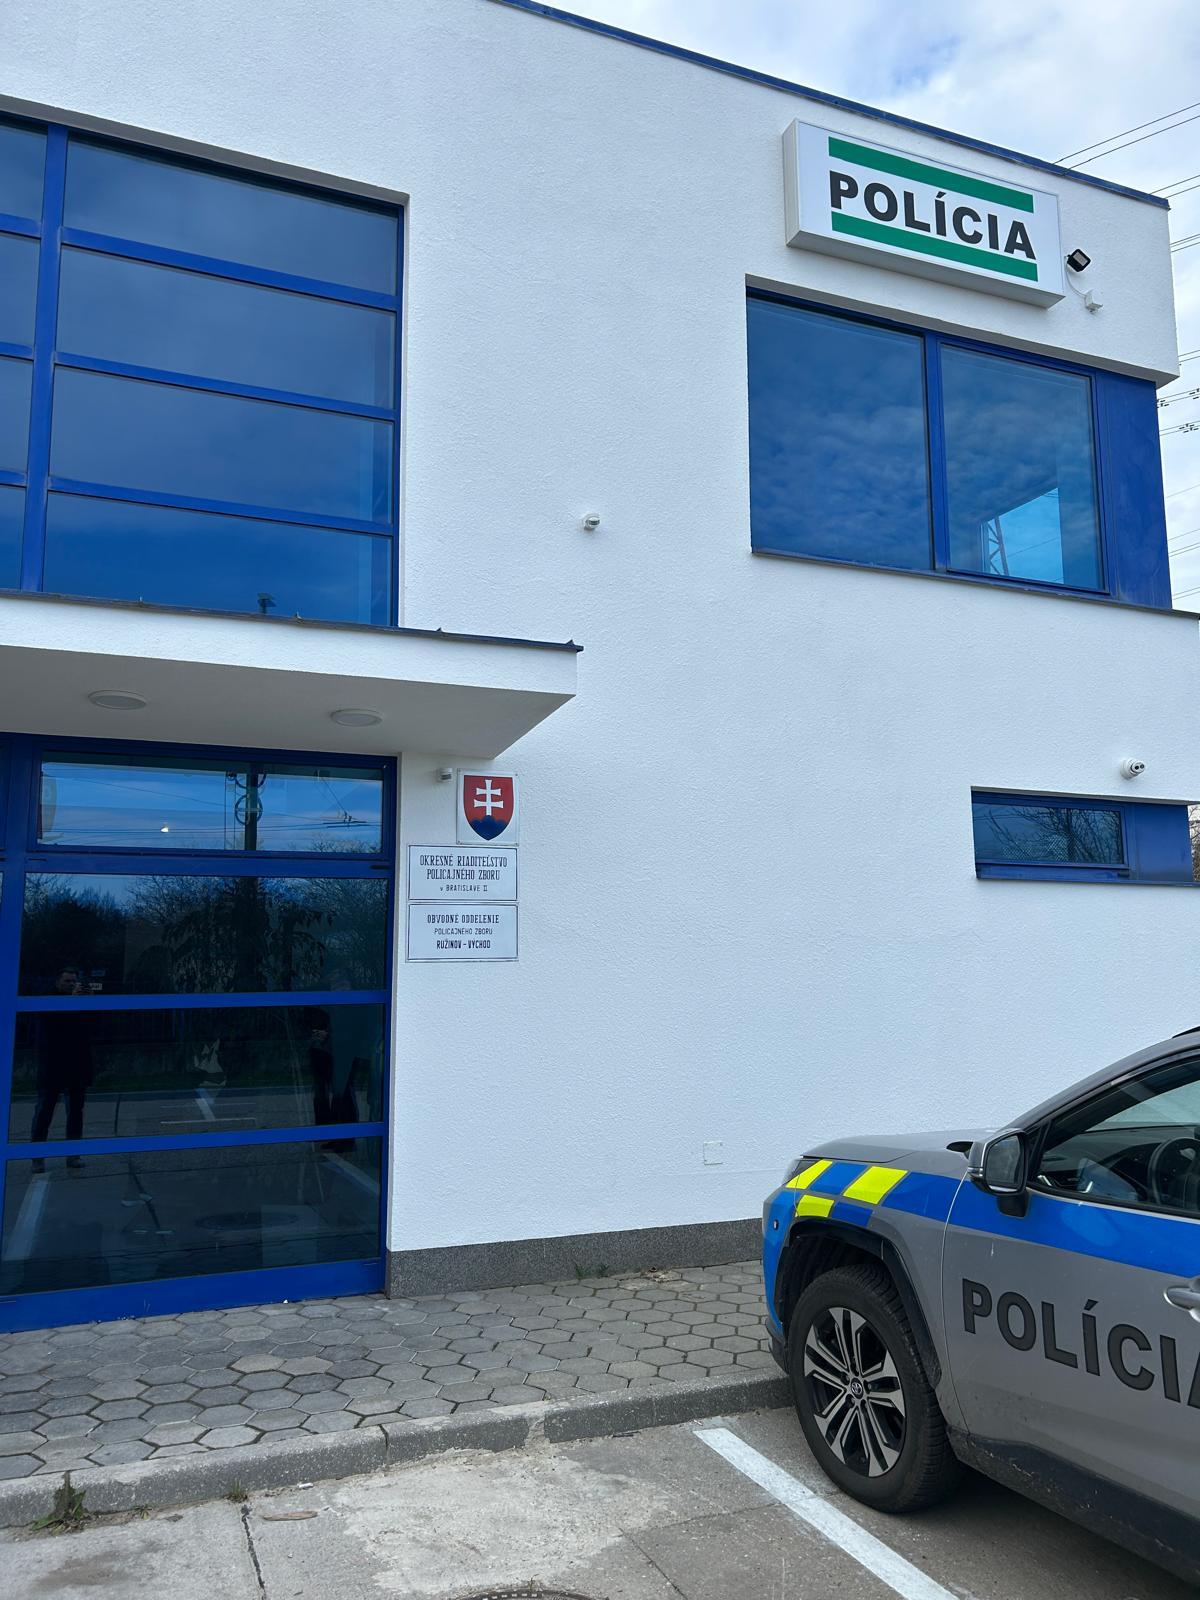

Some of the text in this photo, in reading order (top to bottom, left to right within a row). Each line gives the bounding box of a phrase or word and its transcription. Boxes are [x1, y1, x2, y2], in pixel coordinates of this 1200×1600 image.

[829, 170, 1036, 260] POLÍCIA
[419, 854, 454, 866] OKRESNÉ
[426, 868, 500, 880] POLICAJNÉHO ZBORU
[461, 914, 500, 924] ODDELENIE
